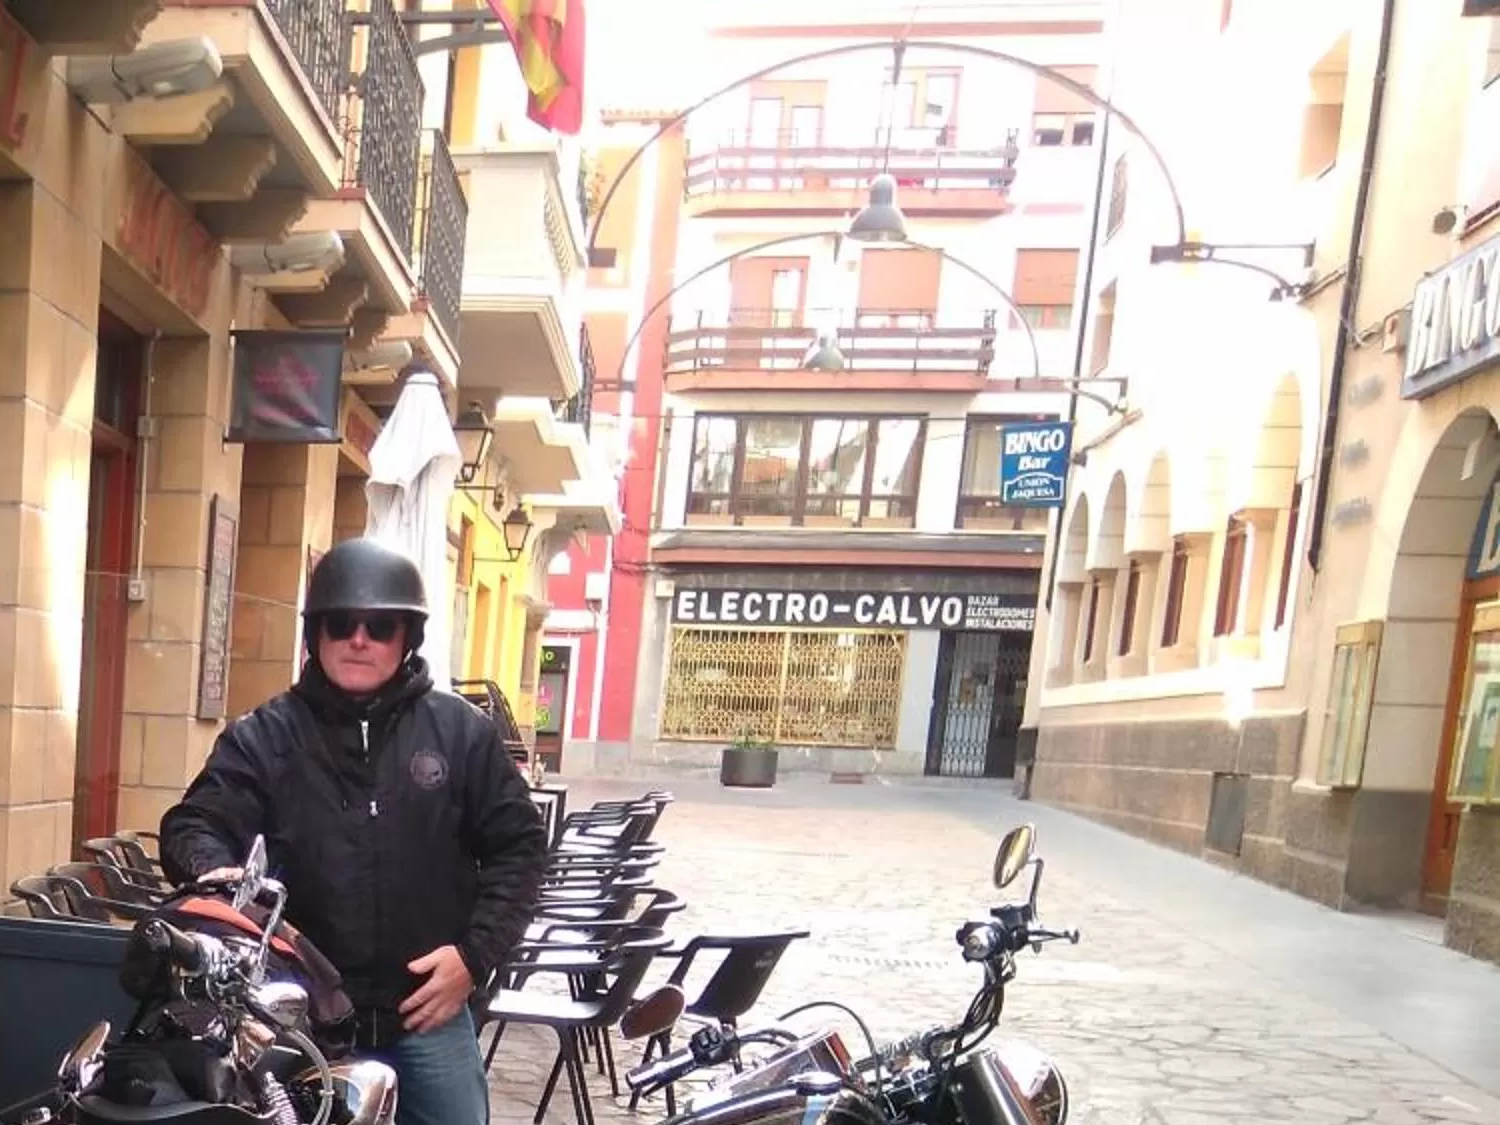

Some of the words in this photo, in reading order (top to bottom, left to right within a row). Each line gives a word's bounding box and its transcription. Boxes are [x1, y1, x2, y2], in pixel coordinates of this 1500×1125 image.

[1005, 429, 1065, 455] BINGO
[1018, 455, 1052, 471] Bar
[677, 591, 963, 626] ELECTRO-CALVO
